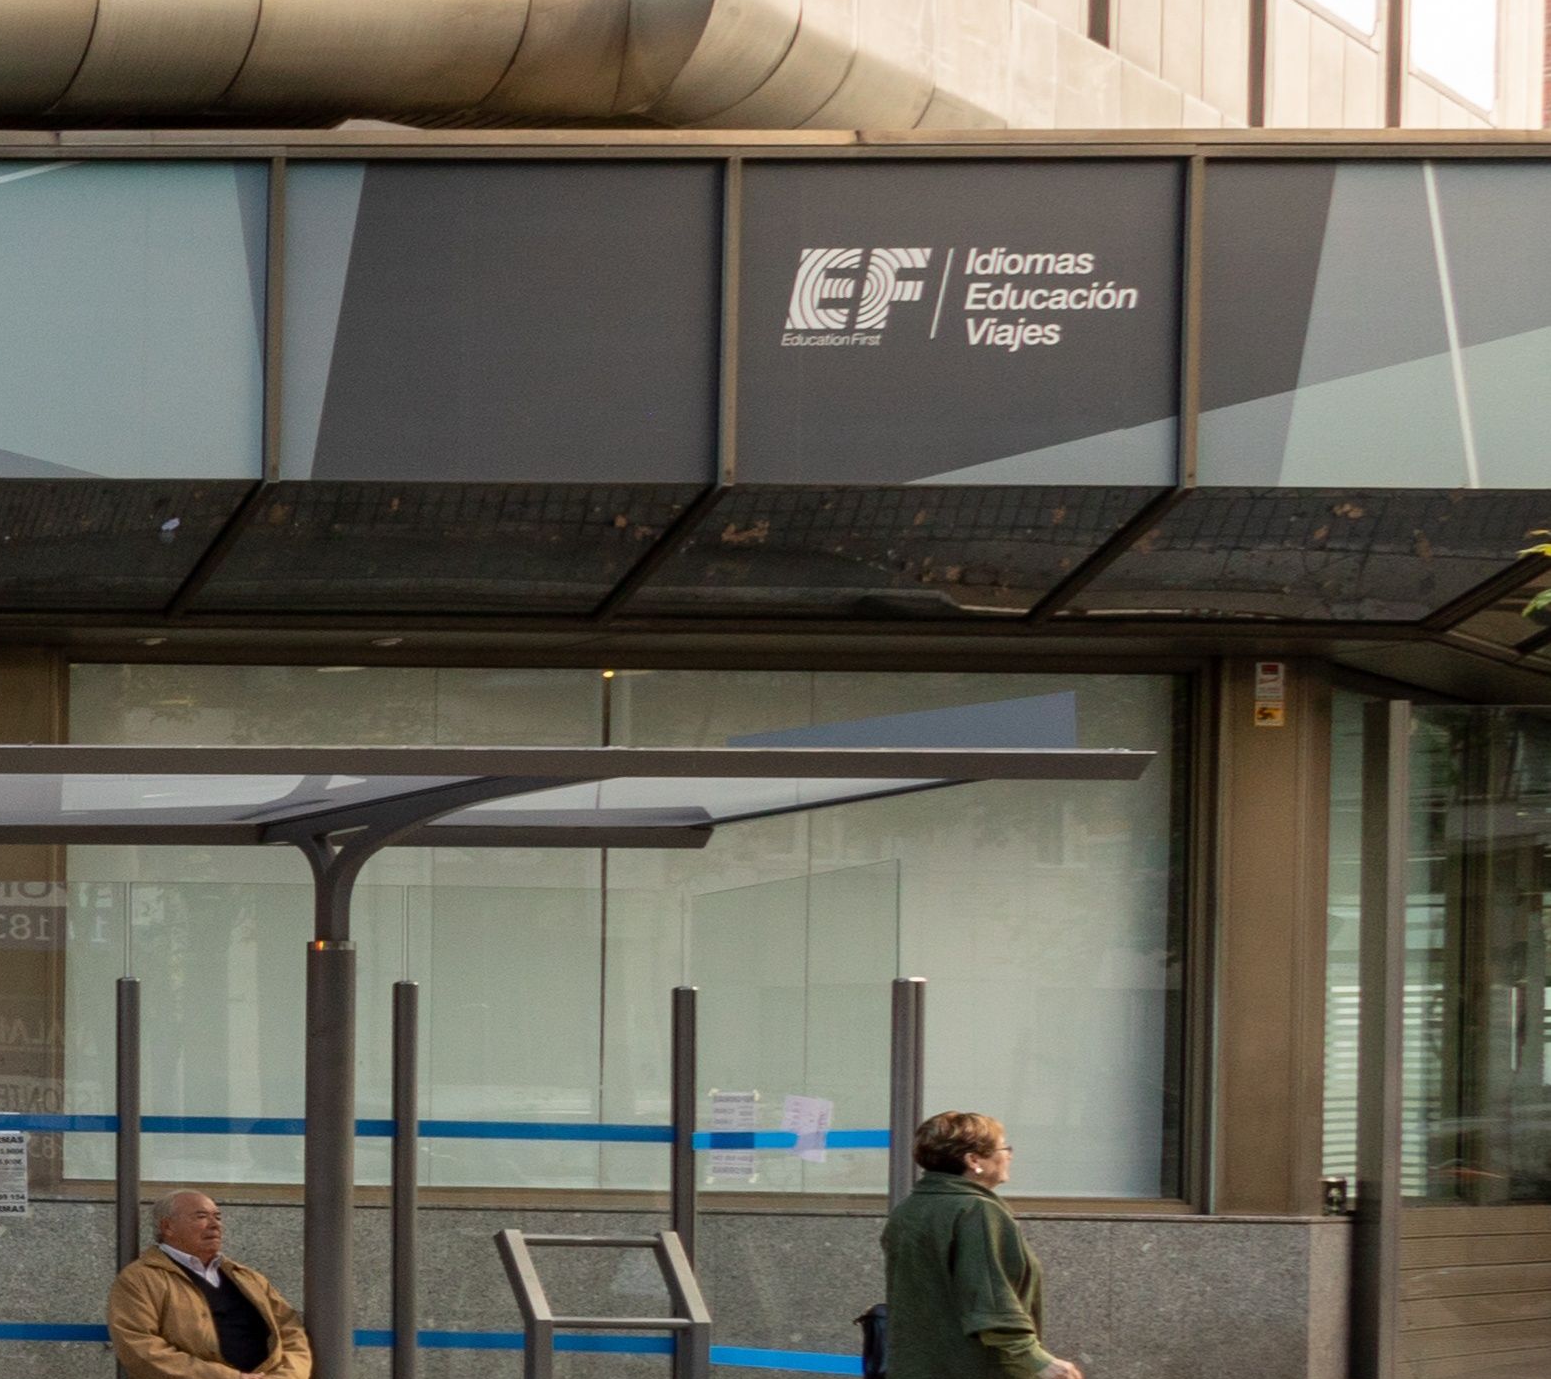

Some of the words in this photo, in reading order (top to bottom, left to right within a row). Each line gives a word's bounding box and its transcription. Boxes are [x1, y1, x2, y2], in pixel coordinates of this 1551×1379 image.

[965, 247, 1094, 275] Idiomas
[785, 248, 932, 329] EF
[965, 281, 1138, 310] Educación
[781, 333, 849, 346] Education
[851, 333, 882, 346] First
[967, 318, 1061, 352] Viajes
